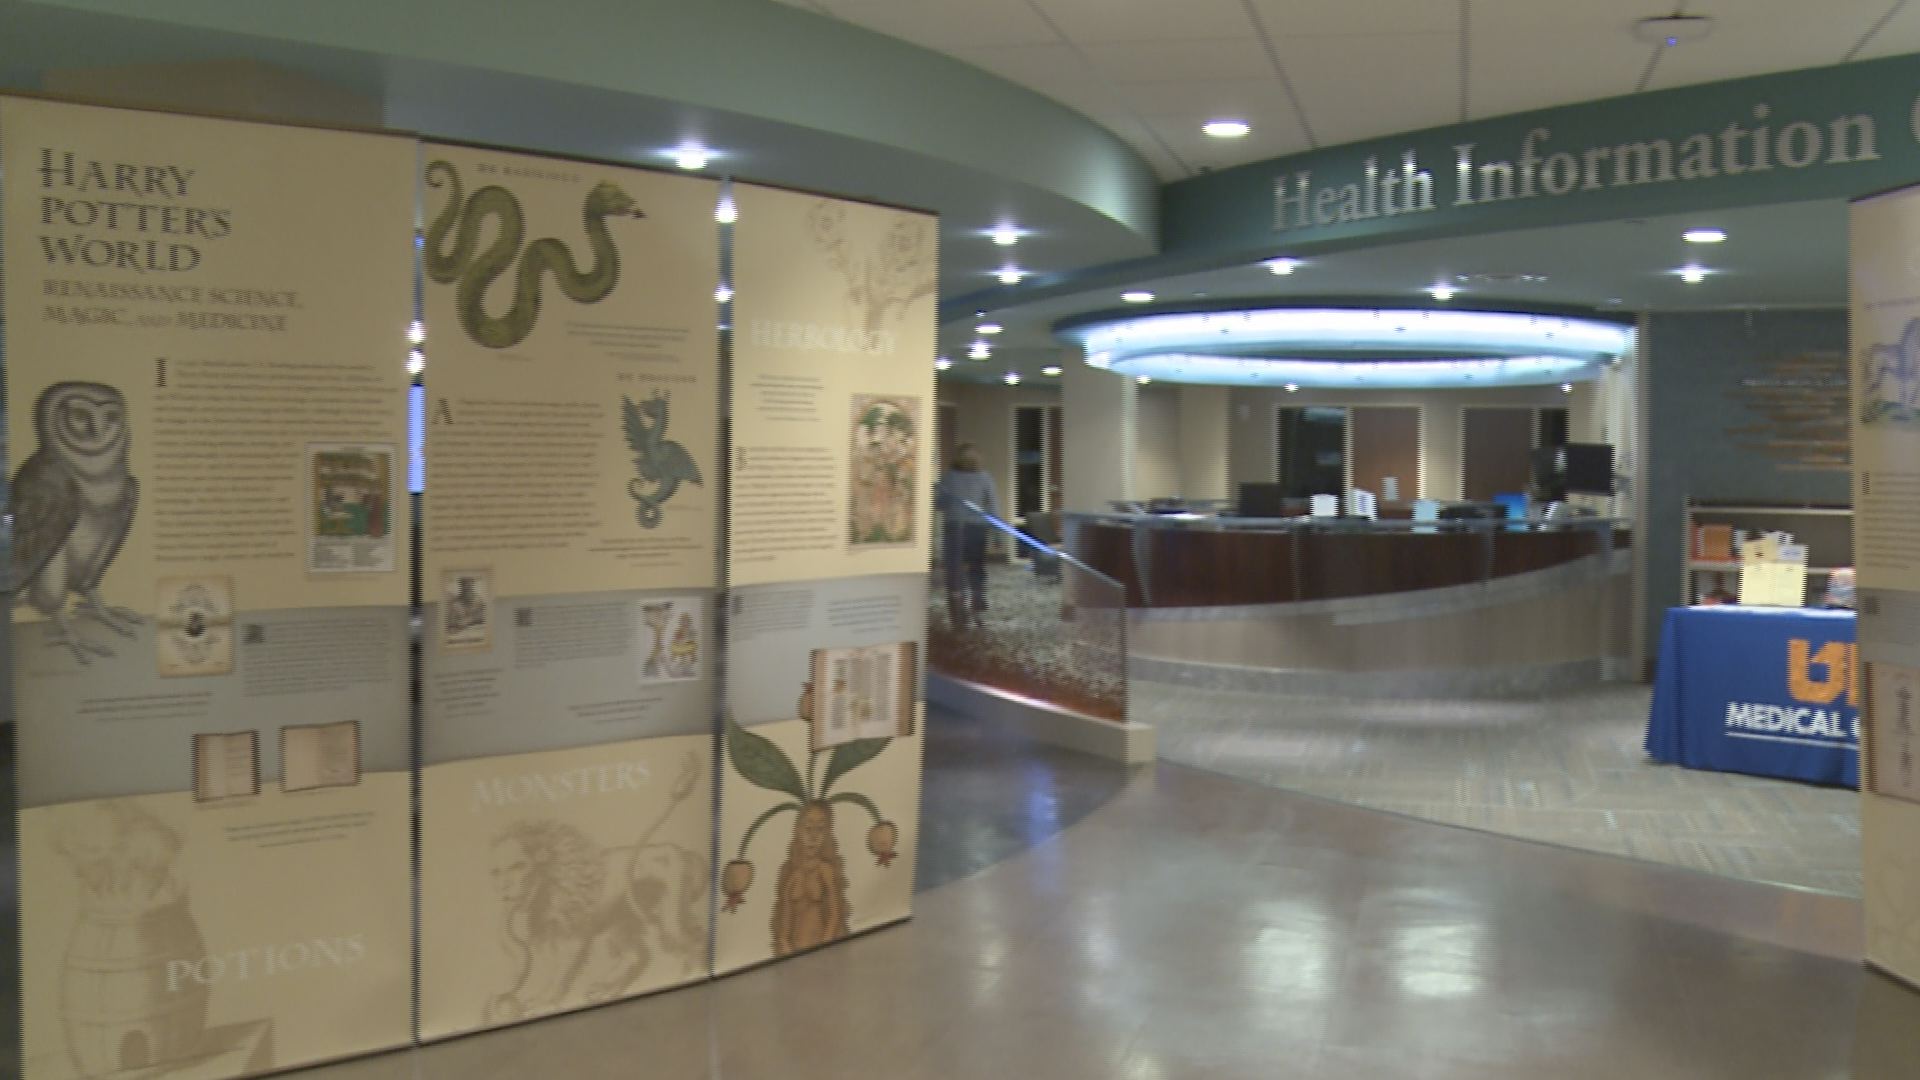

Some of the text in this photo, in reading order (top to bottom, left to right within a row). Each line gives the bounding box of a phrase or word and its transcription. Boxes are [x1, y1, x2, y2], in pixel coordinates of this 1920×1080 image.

[37, 147, 197, 199] HARRY
[1272, 150, 1437, 232] Health
[1451, 103, 1883, 207] Information
[38, 233, 202, 274] WORLD
[42, 278, 201, 304] RENAISSANCE
[174, 310, 289, 332] MEDICINE
[1725, 701, 1848, 737] MEDICAL
[469, 759, 651, 813] MONSTERS
[165, 932, 367, 992] POTIONS
